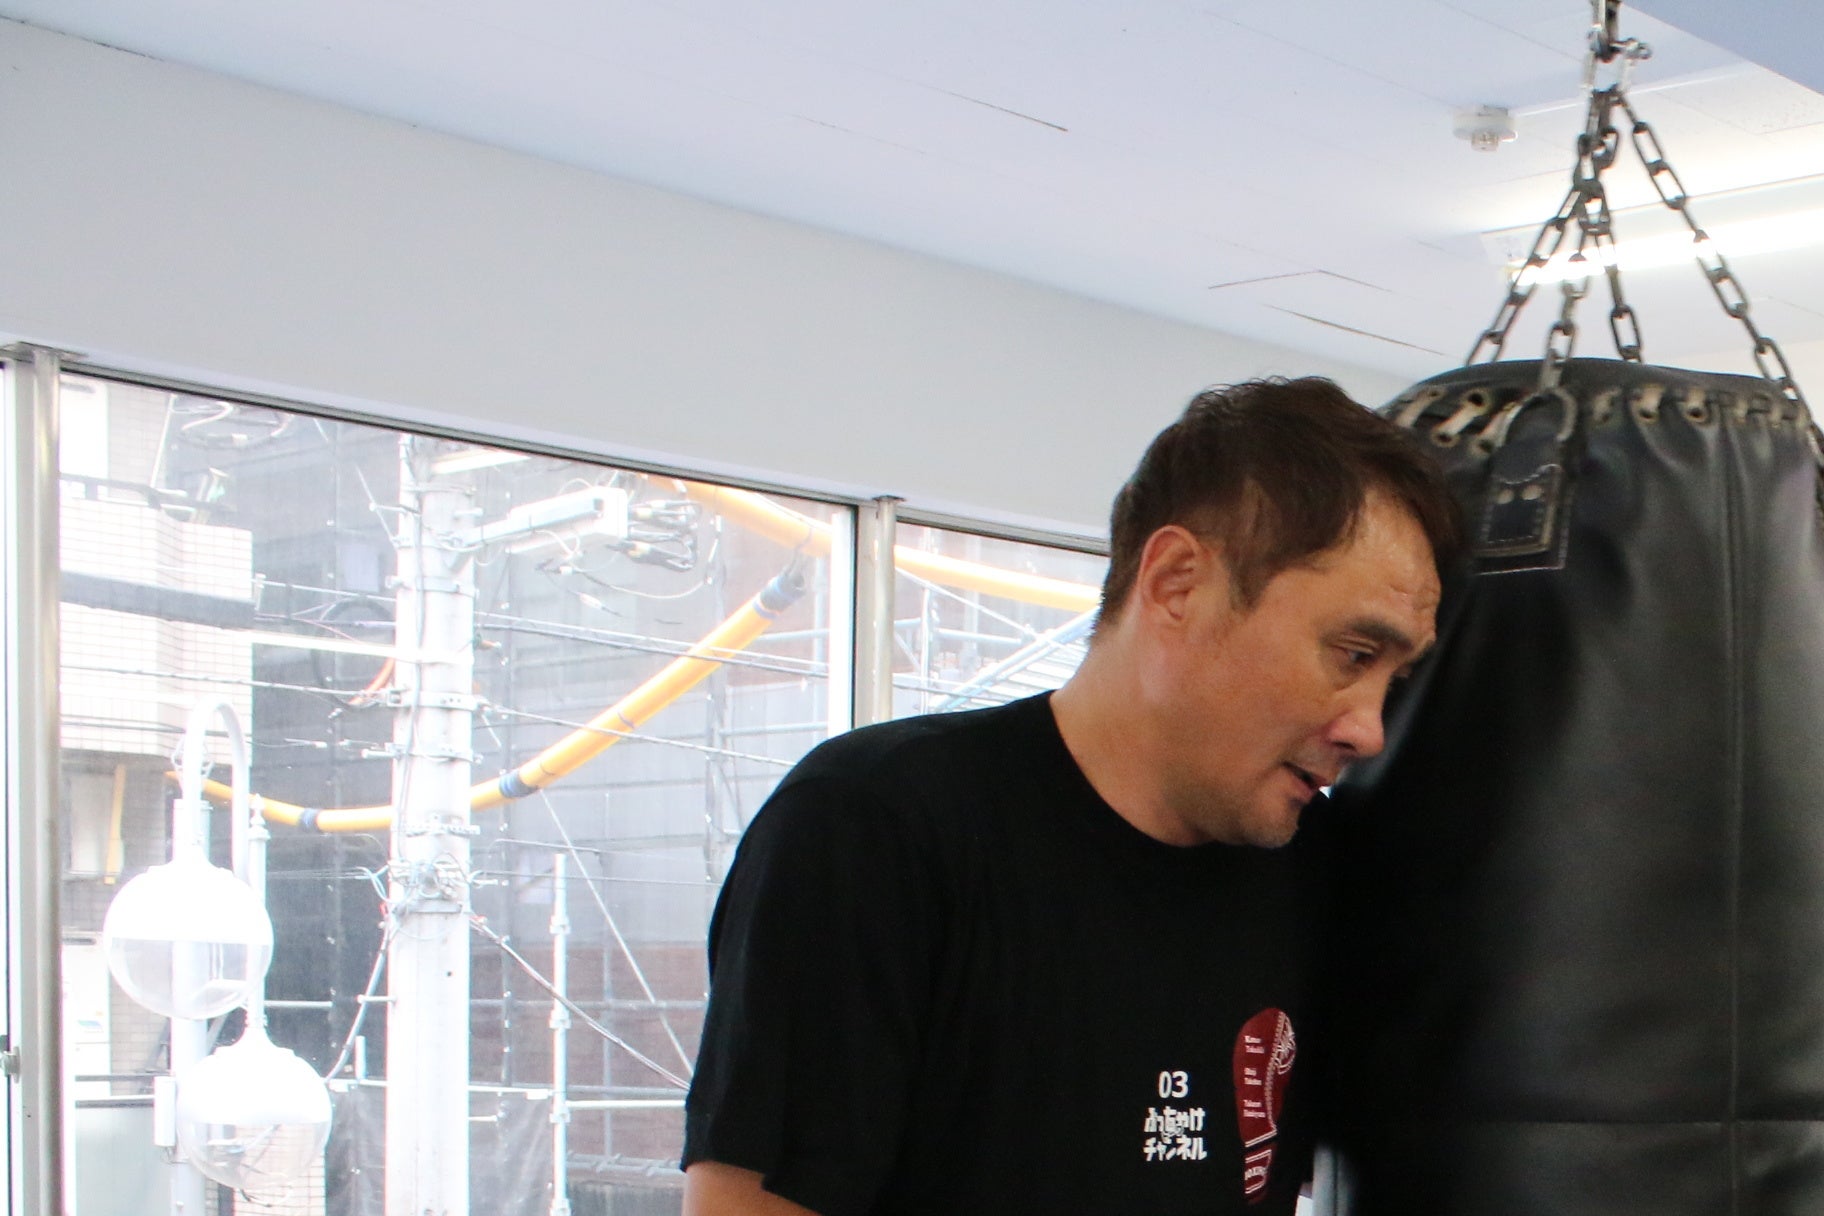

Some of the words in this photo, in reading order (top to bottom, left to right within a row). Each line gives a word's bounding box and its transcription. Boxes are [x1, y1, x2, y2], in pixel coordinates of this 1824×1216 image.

[1143, 1135, 1208, 1162] チャンネル
